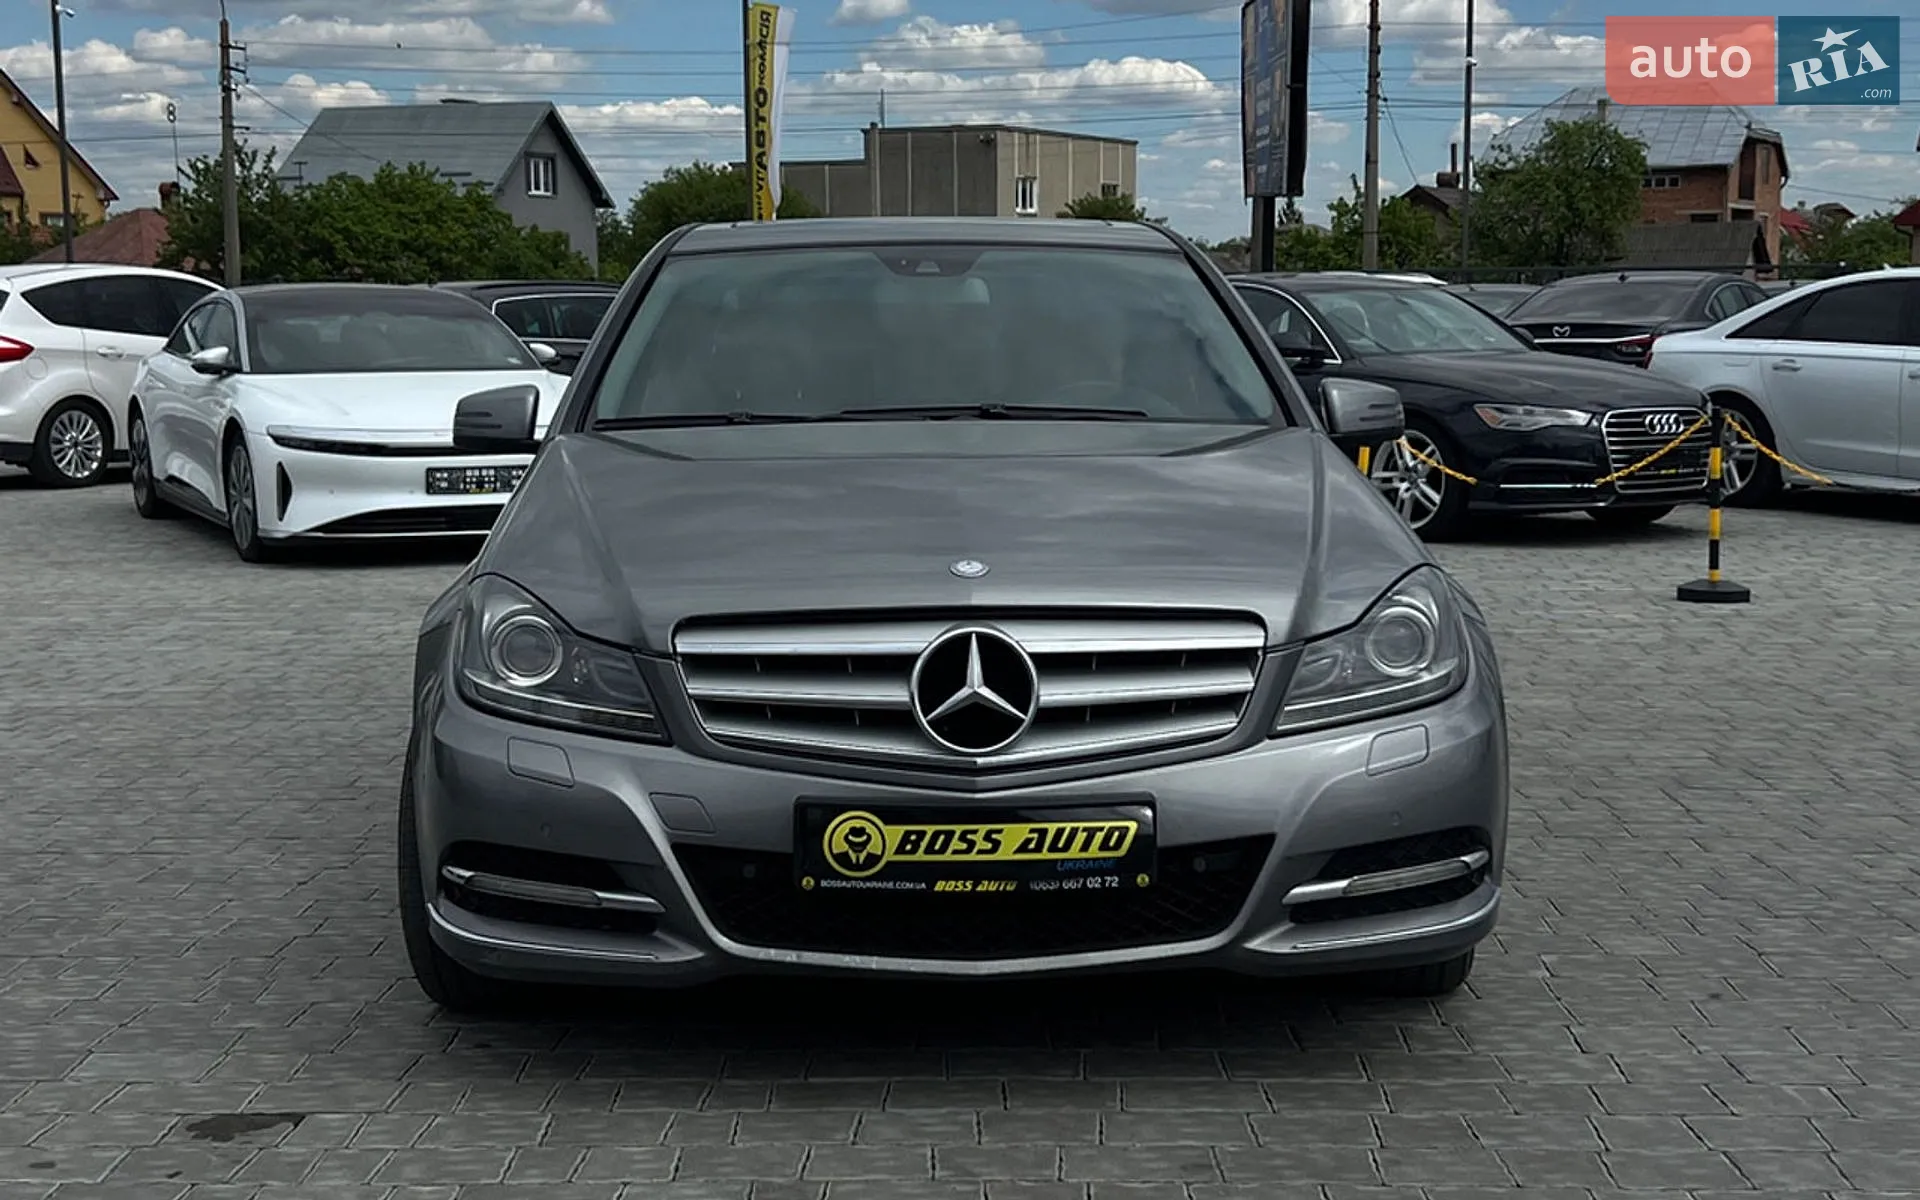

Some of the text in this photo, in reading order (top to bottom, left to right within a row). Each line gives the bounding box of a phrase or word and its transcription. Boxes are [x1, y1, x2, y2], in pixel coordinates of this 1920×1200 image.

[893, 825, 1131, 856] BOSS AUTO
[1056, 859, 1117, 872] UKRAINE
[933, 880, 1019, 892] BOSS AUTO
[1086, 876, 1102, 889] 02
[1104, 875, 1119, 888] 72
